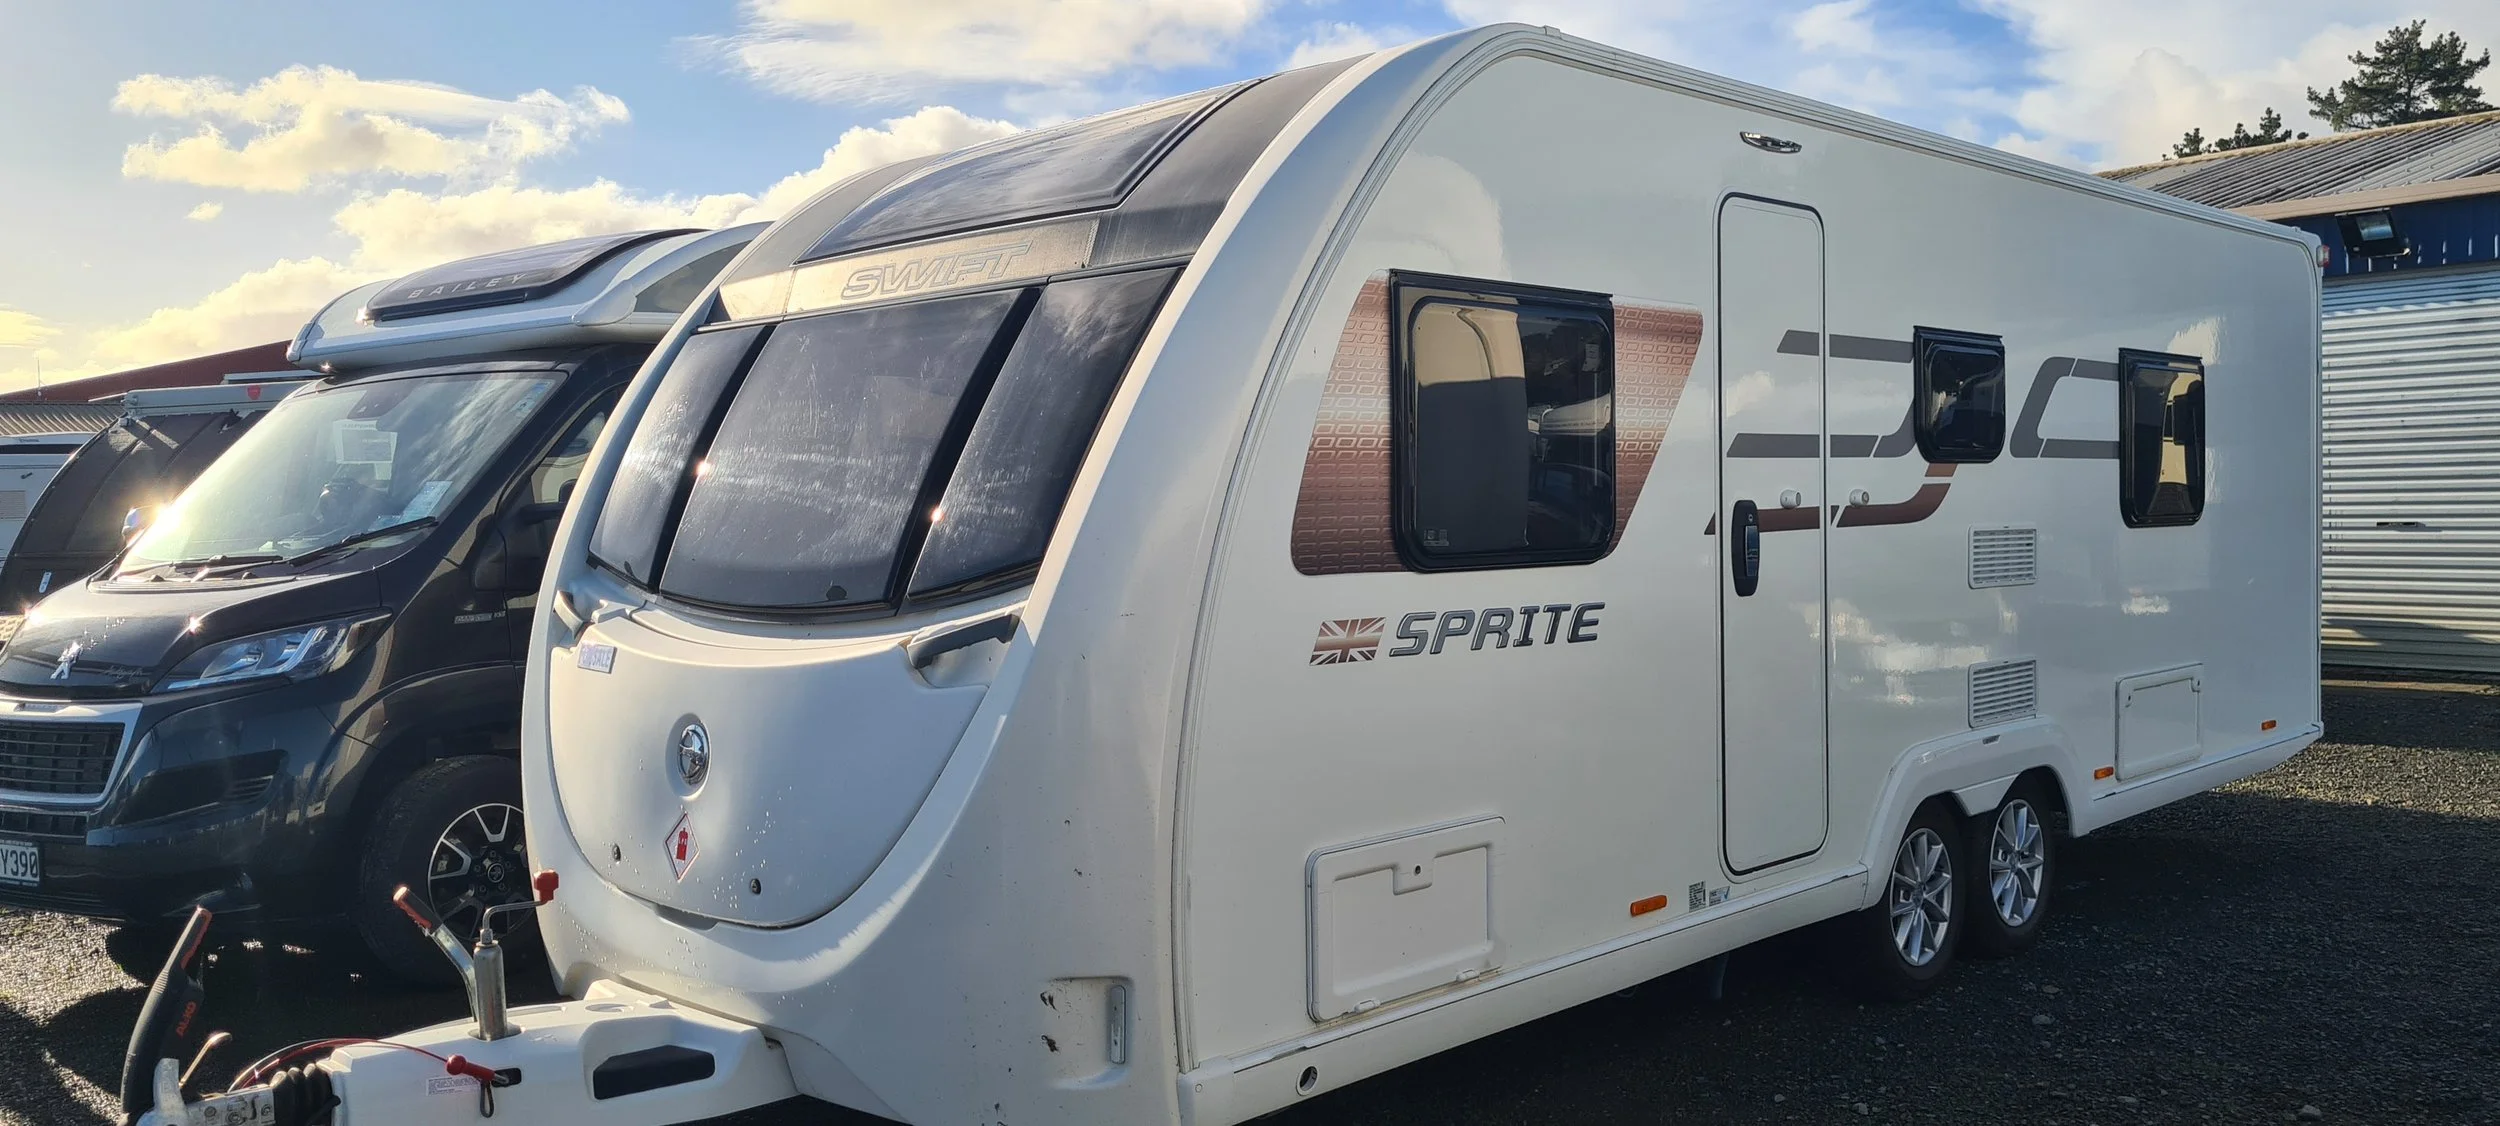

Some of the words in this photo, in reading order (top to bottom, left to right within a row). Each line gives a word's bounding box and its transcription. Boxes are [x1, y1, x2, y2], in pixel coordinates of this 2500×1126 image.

[407, 273, 526, 299] BAILEY
[841, 240, 1033, 300] SWIFT
[1389, 602, 1605, 657] SPRITE
